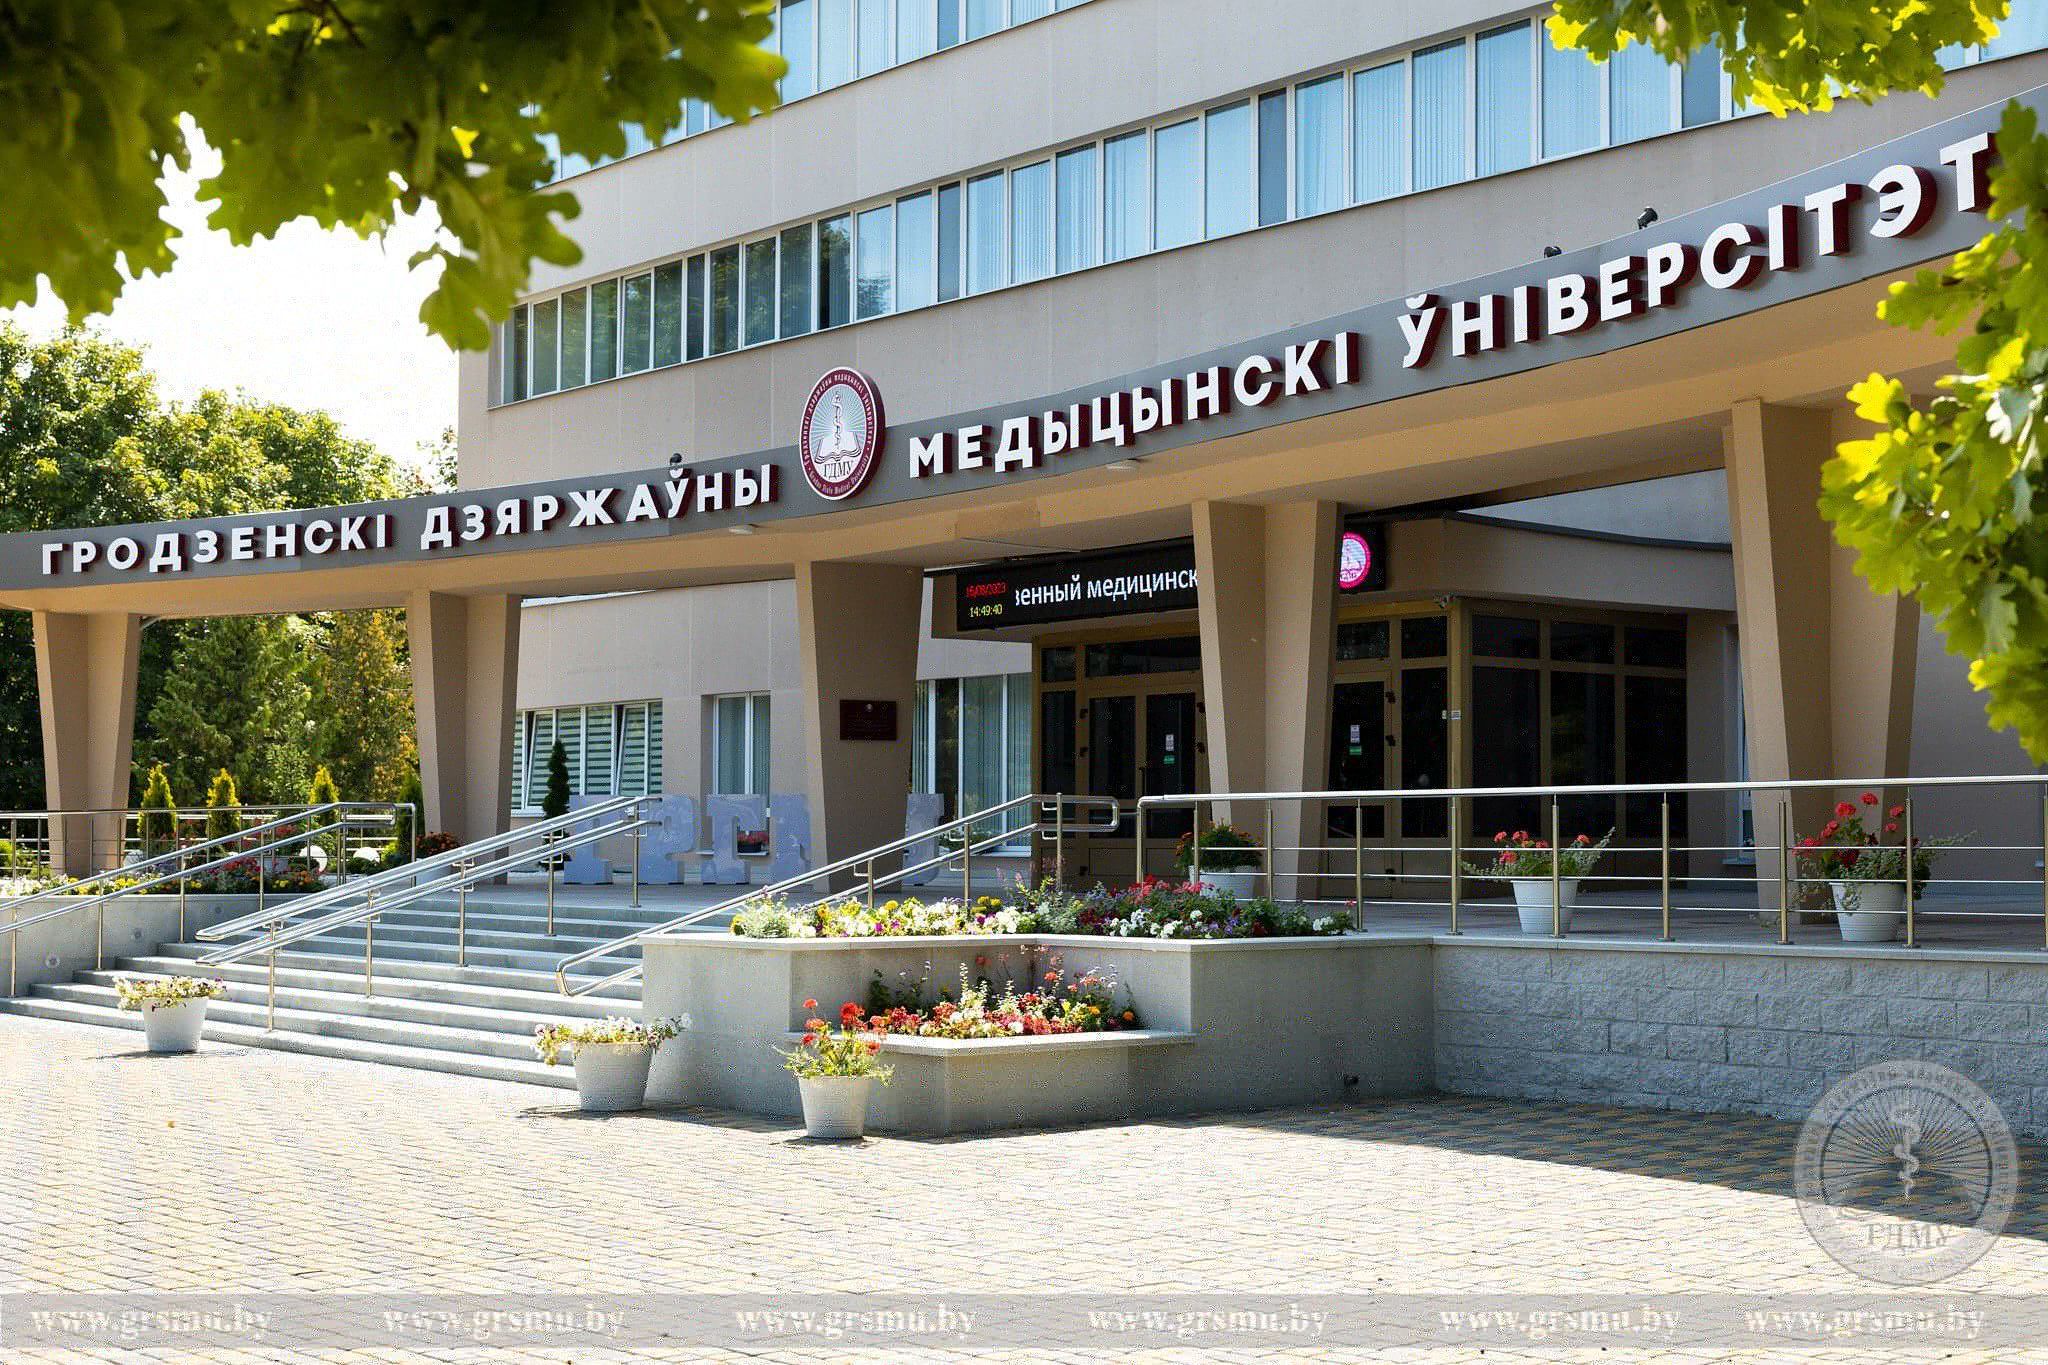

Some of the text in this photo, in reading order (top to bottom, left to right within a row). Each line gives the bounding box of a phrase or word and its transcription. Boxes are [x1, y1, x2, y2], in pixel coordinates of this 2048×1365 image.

[41, 132, 1992, 575] ГРОДЗЕНСКІ ДЗЯРЖАЎНЫ МЕДЫЦЫНСКІ ЎНІВЕРСІТЭТ
[823, 461, 854, 480] ГДМУ
[970, 603, 1003, 618] 14:49:40
